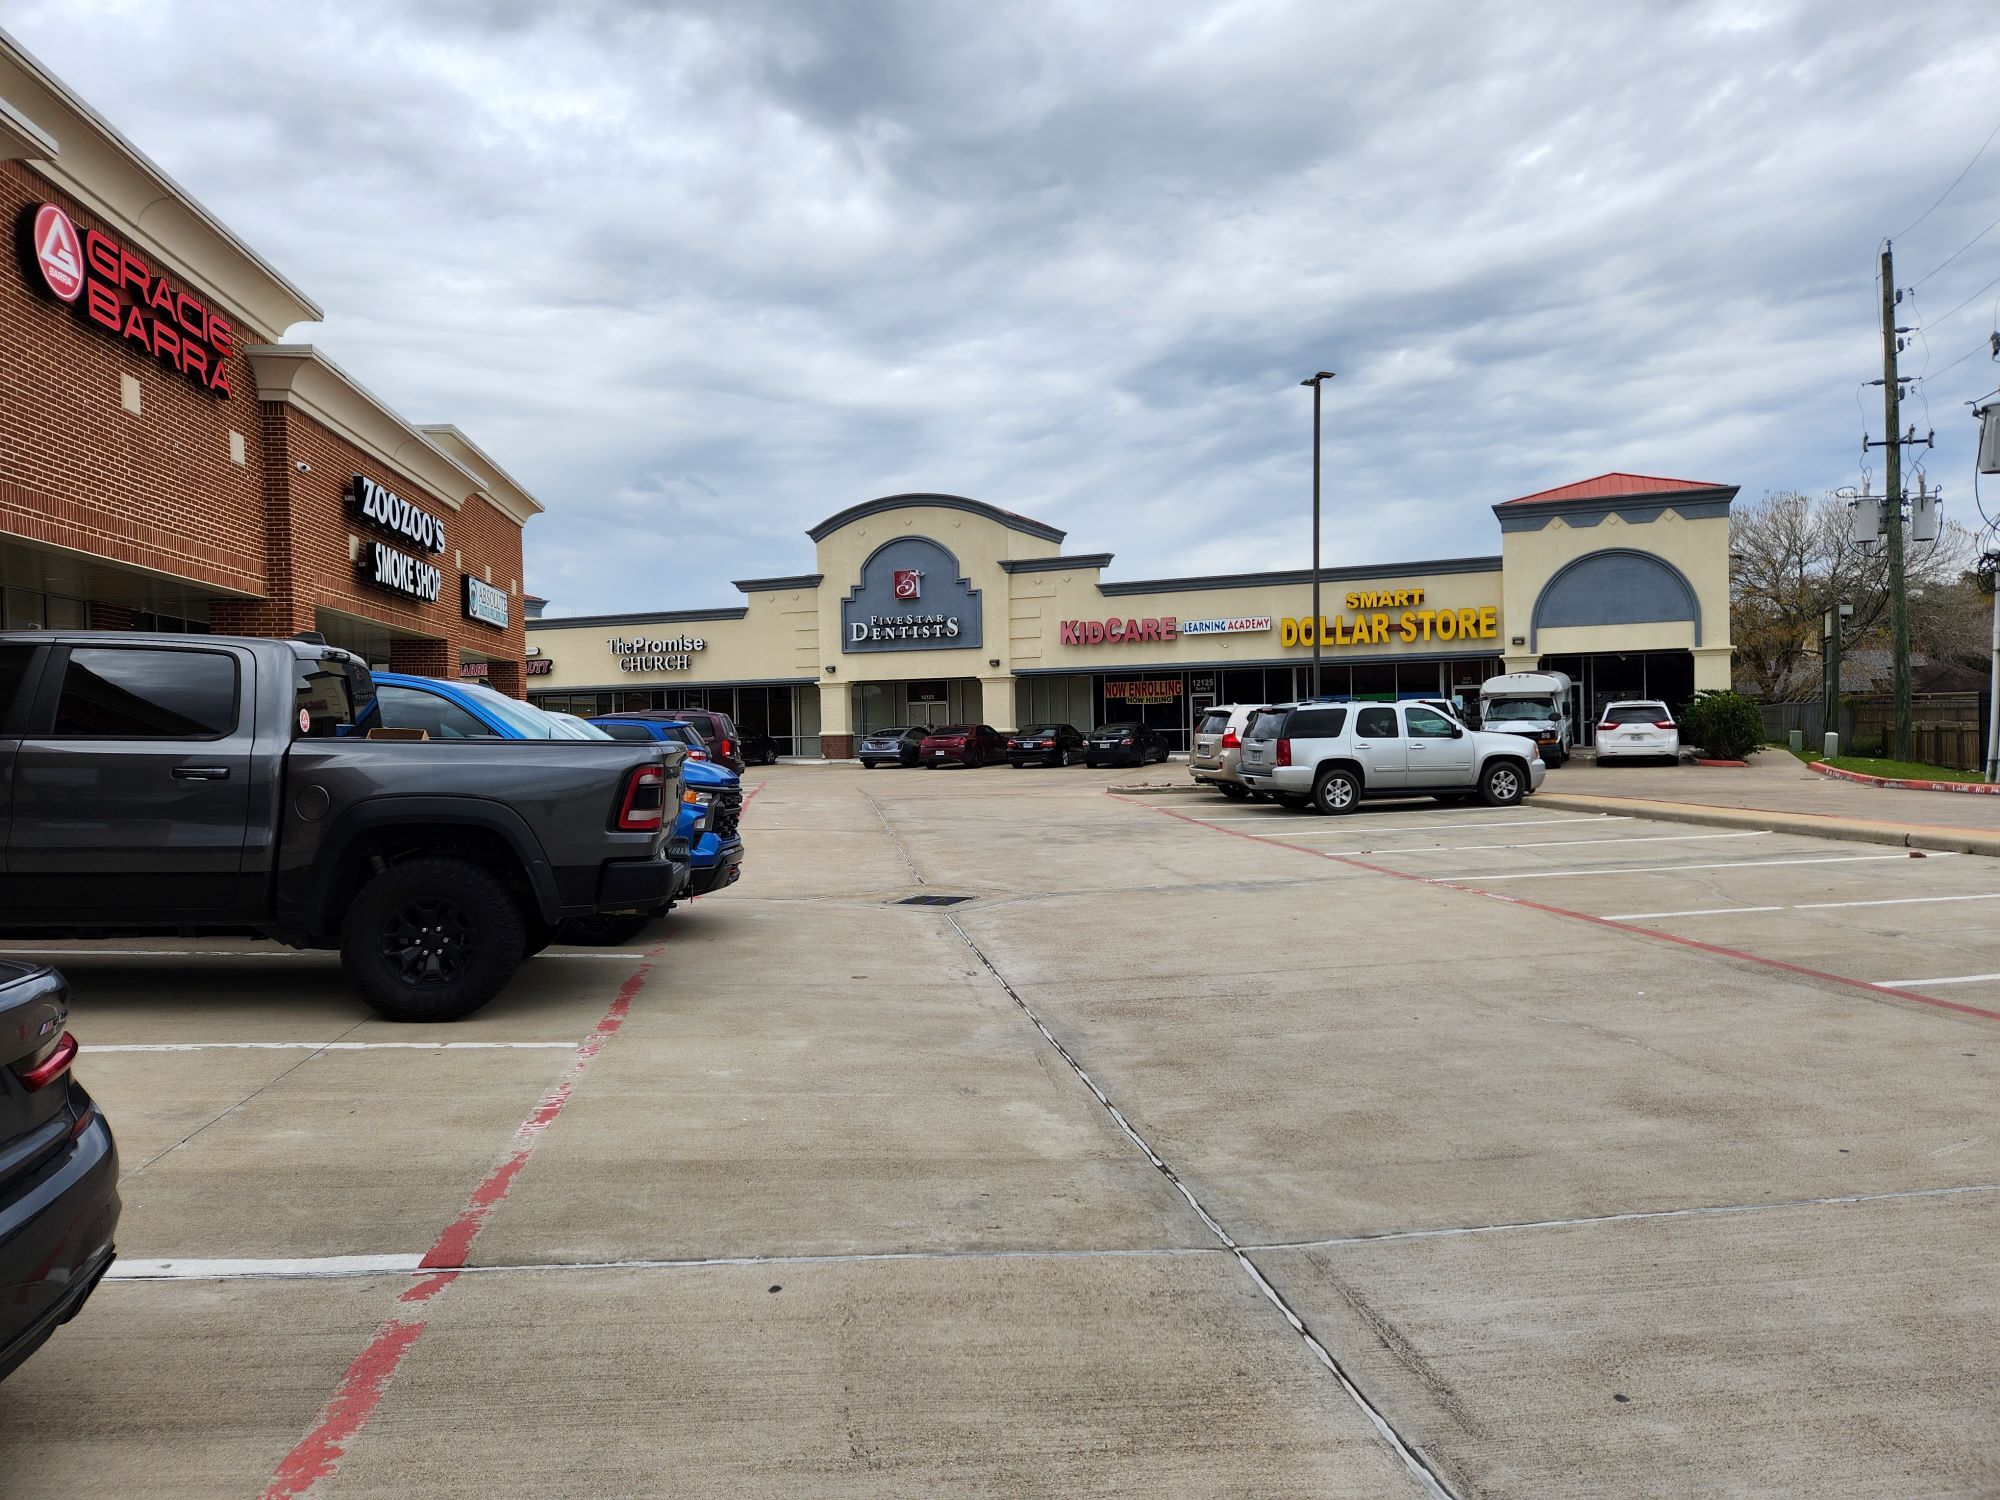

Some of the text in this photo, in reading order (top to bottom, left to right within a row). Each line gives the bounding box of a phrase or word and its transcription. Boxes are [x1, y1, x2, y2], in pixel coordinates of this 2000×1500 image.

[87, 229, 232, 357] GRACIE
[88, 277, 232, 400] BARRA
[363, 477, 445, 554] ZOOZOO'S
[375, 542, 441, 601] SMOKE SHOP
[479, 587, 507, 613] ABSOLUTE
[1346, 589, 1425, 609] SMART
[850, 617, 959, 642] DENTISTS
[1184, 618, 1270, 633] LEARNING ACADEMY
[1281, 606, 1497, 647] DOLLAR STORE
[619, 654, 690, 673] CHURCH
[1105, 681, 1182, 697] NOW ENROLLING
[1192, 679, 1214, 687] 12125
